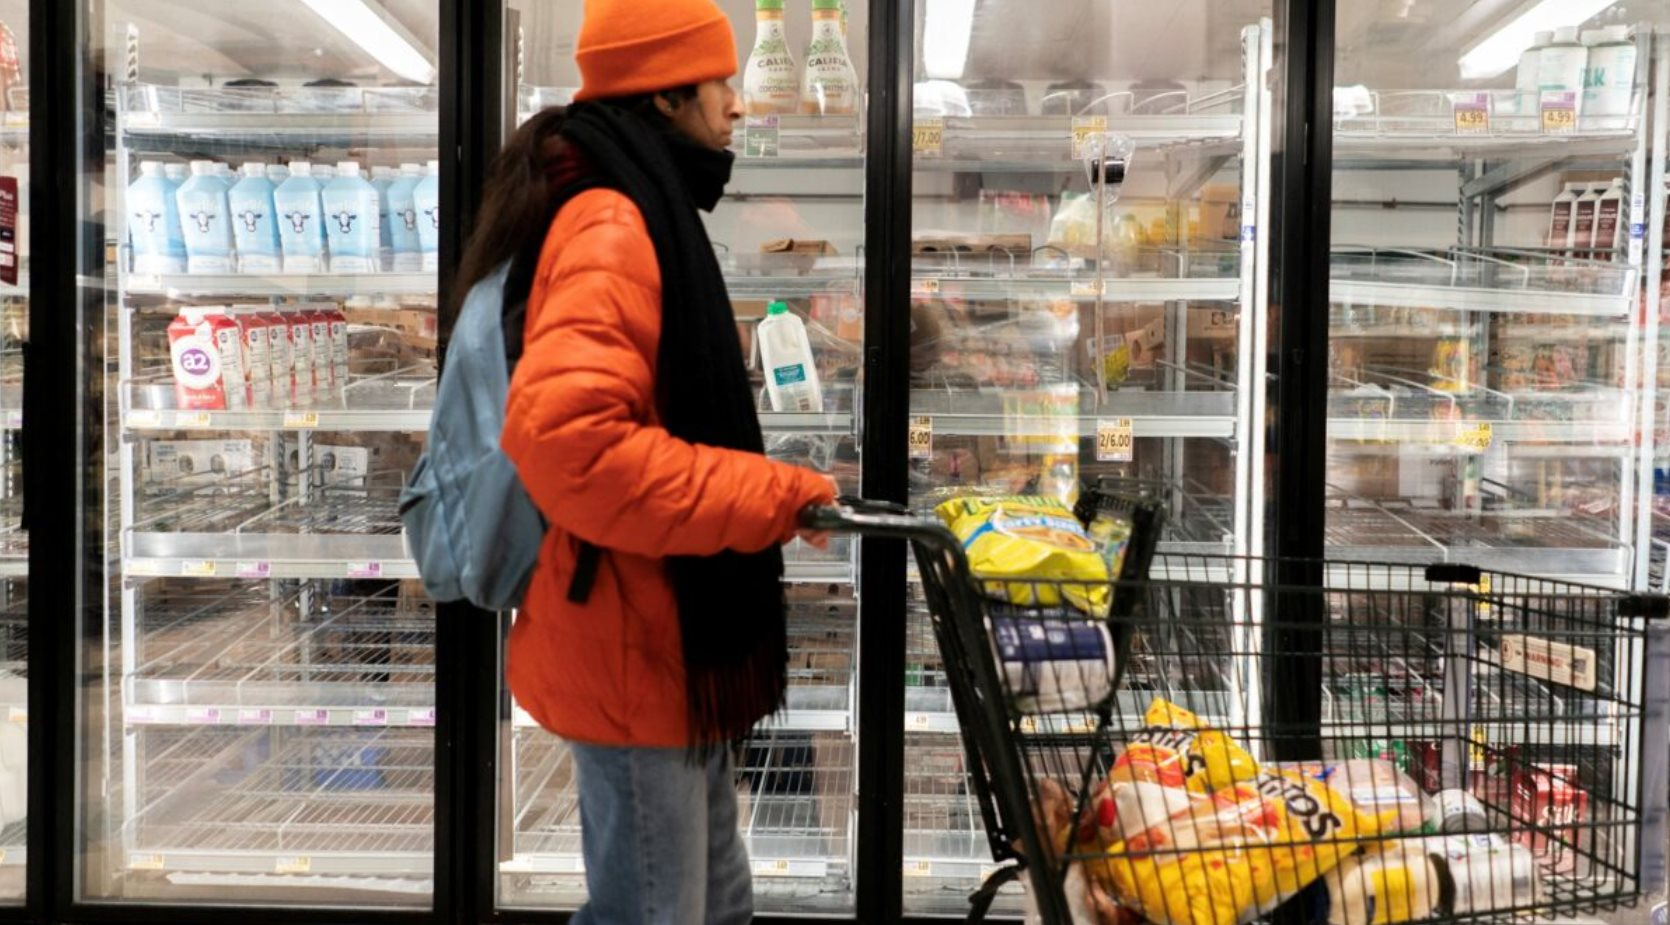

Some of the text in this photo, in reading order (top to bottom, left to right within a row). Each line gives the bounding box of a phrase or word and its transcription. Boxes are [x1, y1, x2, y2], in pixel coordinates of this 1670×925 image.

[1459, 111, 1484, 123] 4.99
[1547, 111, 1571, 123] 4.99
[912, 130, 941, 146] /7.00
[183, 353, 208, 370] a2
[1100, 433, 1129, 448] 2/6.00
